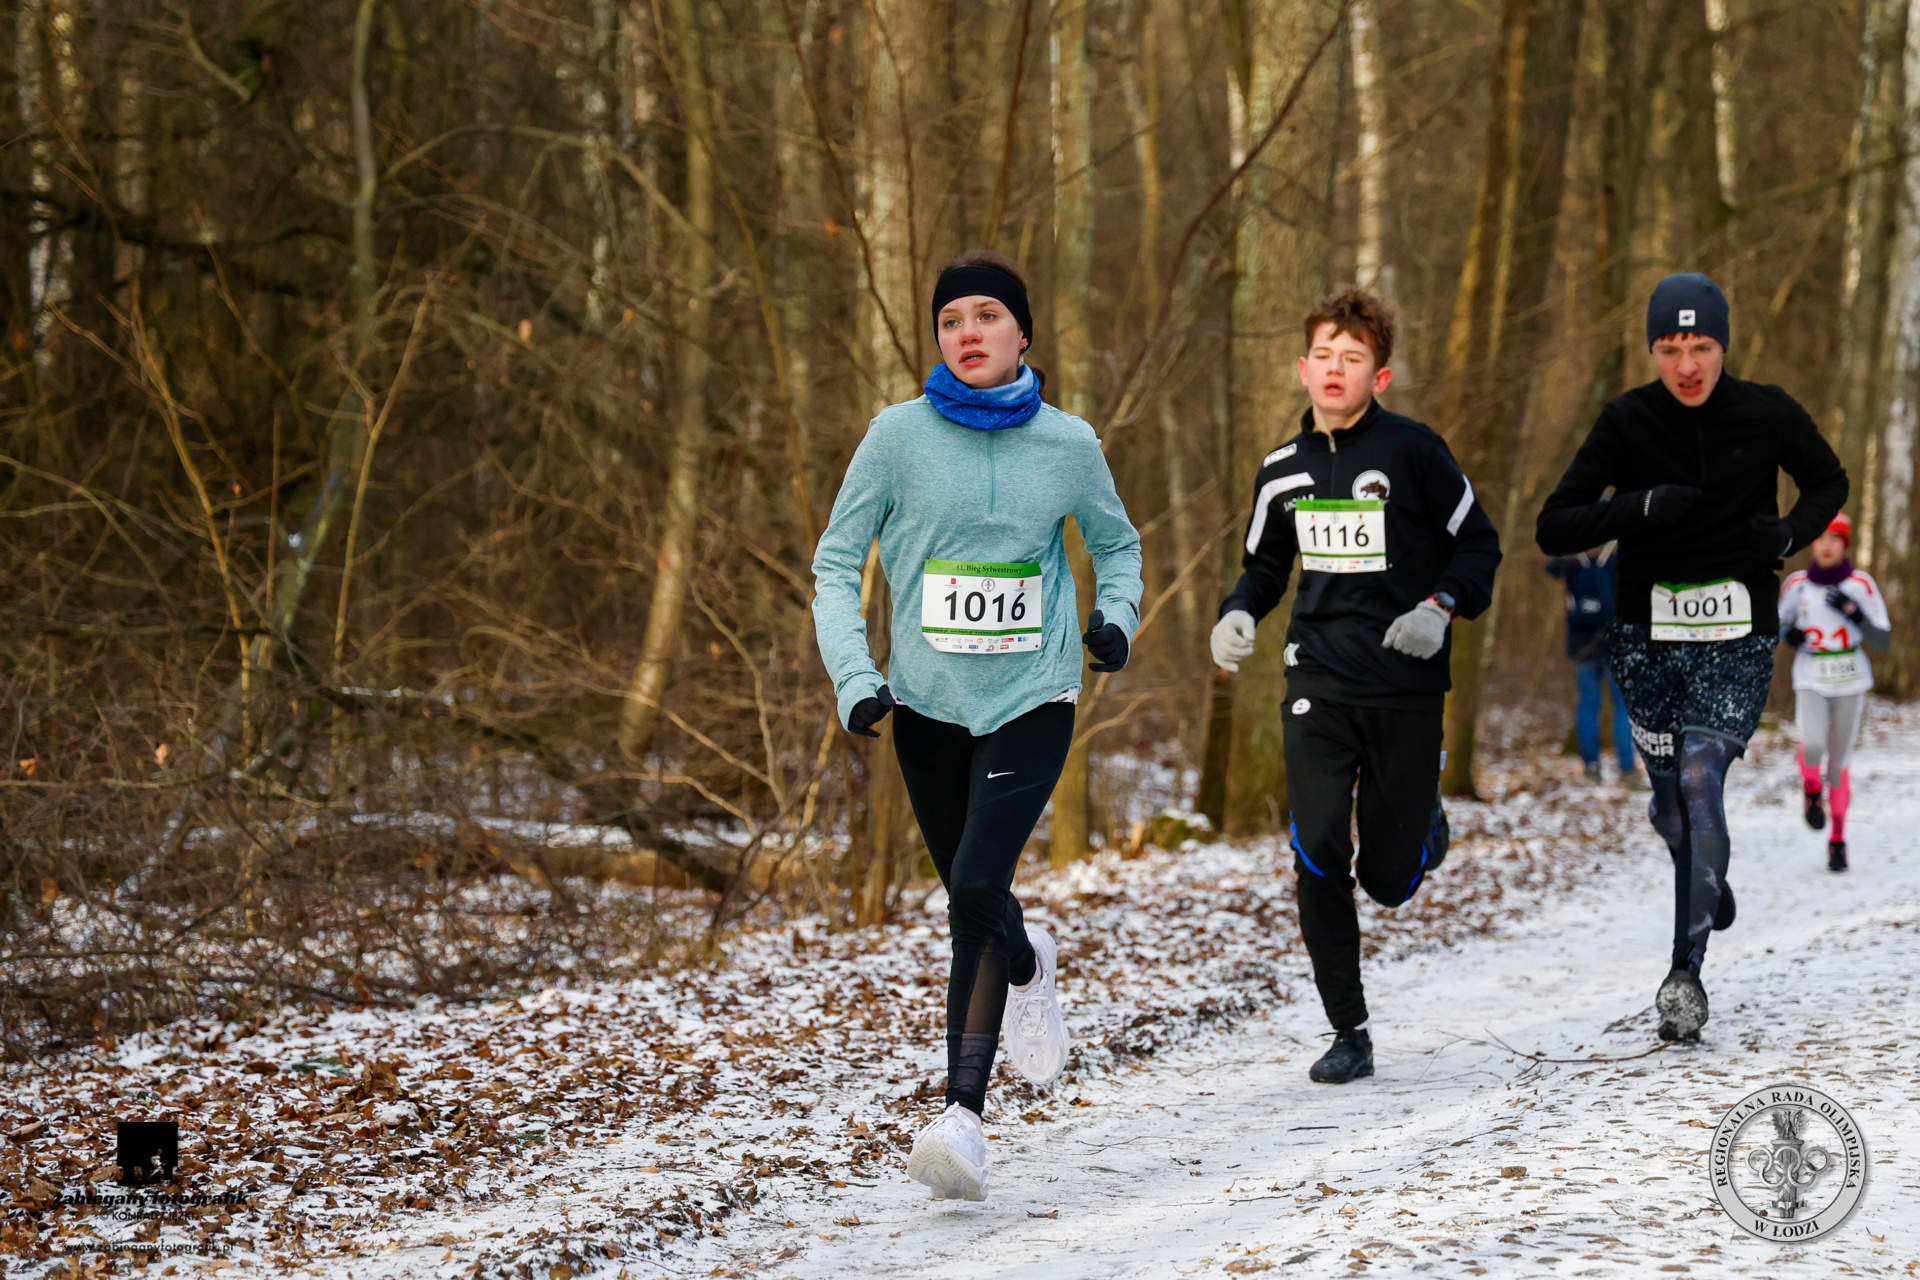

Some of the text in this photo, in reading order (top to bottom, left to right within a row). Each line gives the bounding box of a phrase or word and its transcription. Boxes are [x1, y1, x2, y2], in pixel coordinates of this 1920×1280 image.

[1309, 524, 1369, 547] 1116
[944, 590, 1026, 622] 1016
[1668, 593, 1732, 617] 1001
